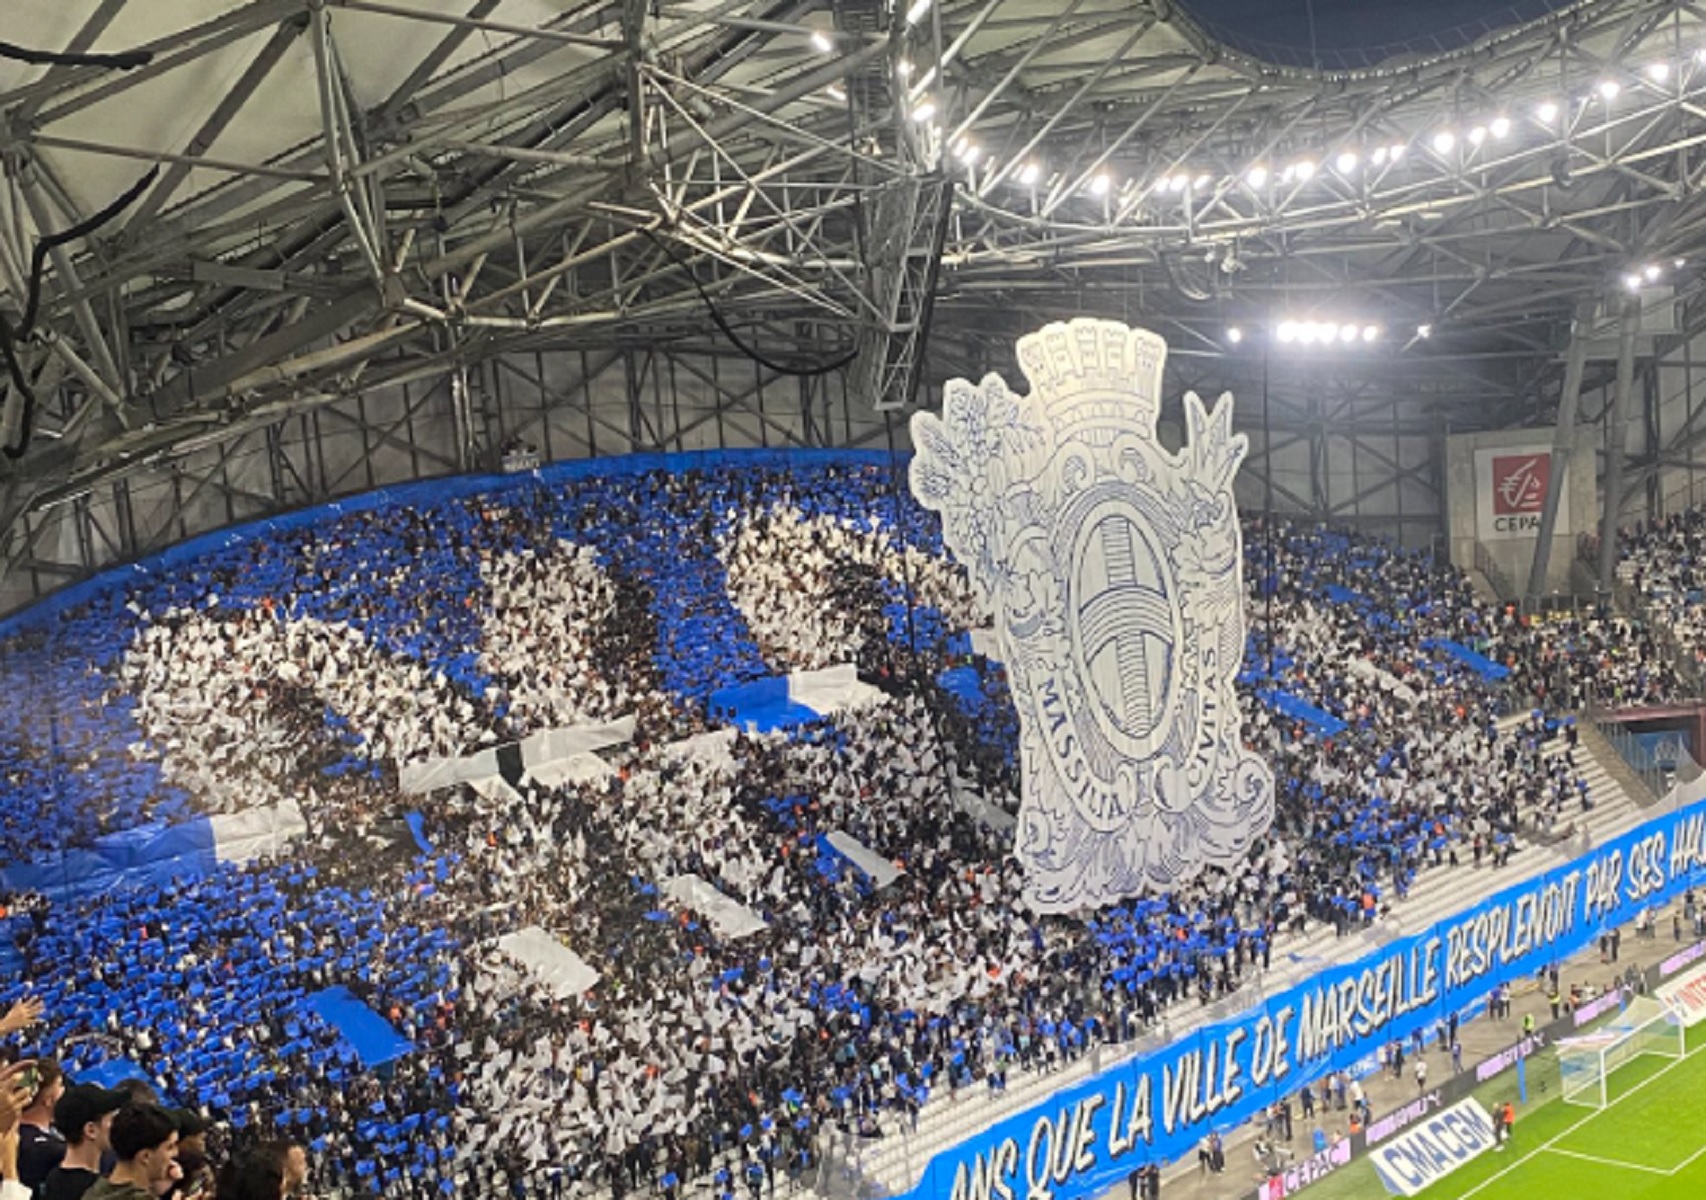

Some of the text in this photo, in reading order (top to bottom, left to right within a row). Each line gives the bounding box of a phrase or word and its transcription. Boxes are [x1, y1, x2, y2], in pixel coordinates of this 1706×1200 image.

[1037, 648, 1217, 820] MASSILIA CIVITAS
[1026, 1092, 1105, 1200] QUE
[1108, 1072, 1153, 1158] LA
[1162, 1026, 1247, 1135] VILLE
[1252, 1005, 1294, 1086] DE
[1296, 936, 1442, 1066] MARSEILLE
[1445, 870, 1580, 993] RESPLENDIT
[1584, 849, 1622, 925] PAR
[1625, 830, 1666, 900] SES
[1285, 1143, 1342, 1194] CEPAC
